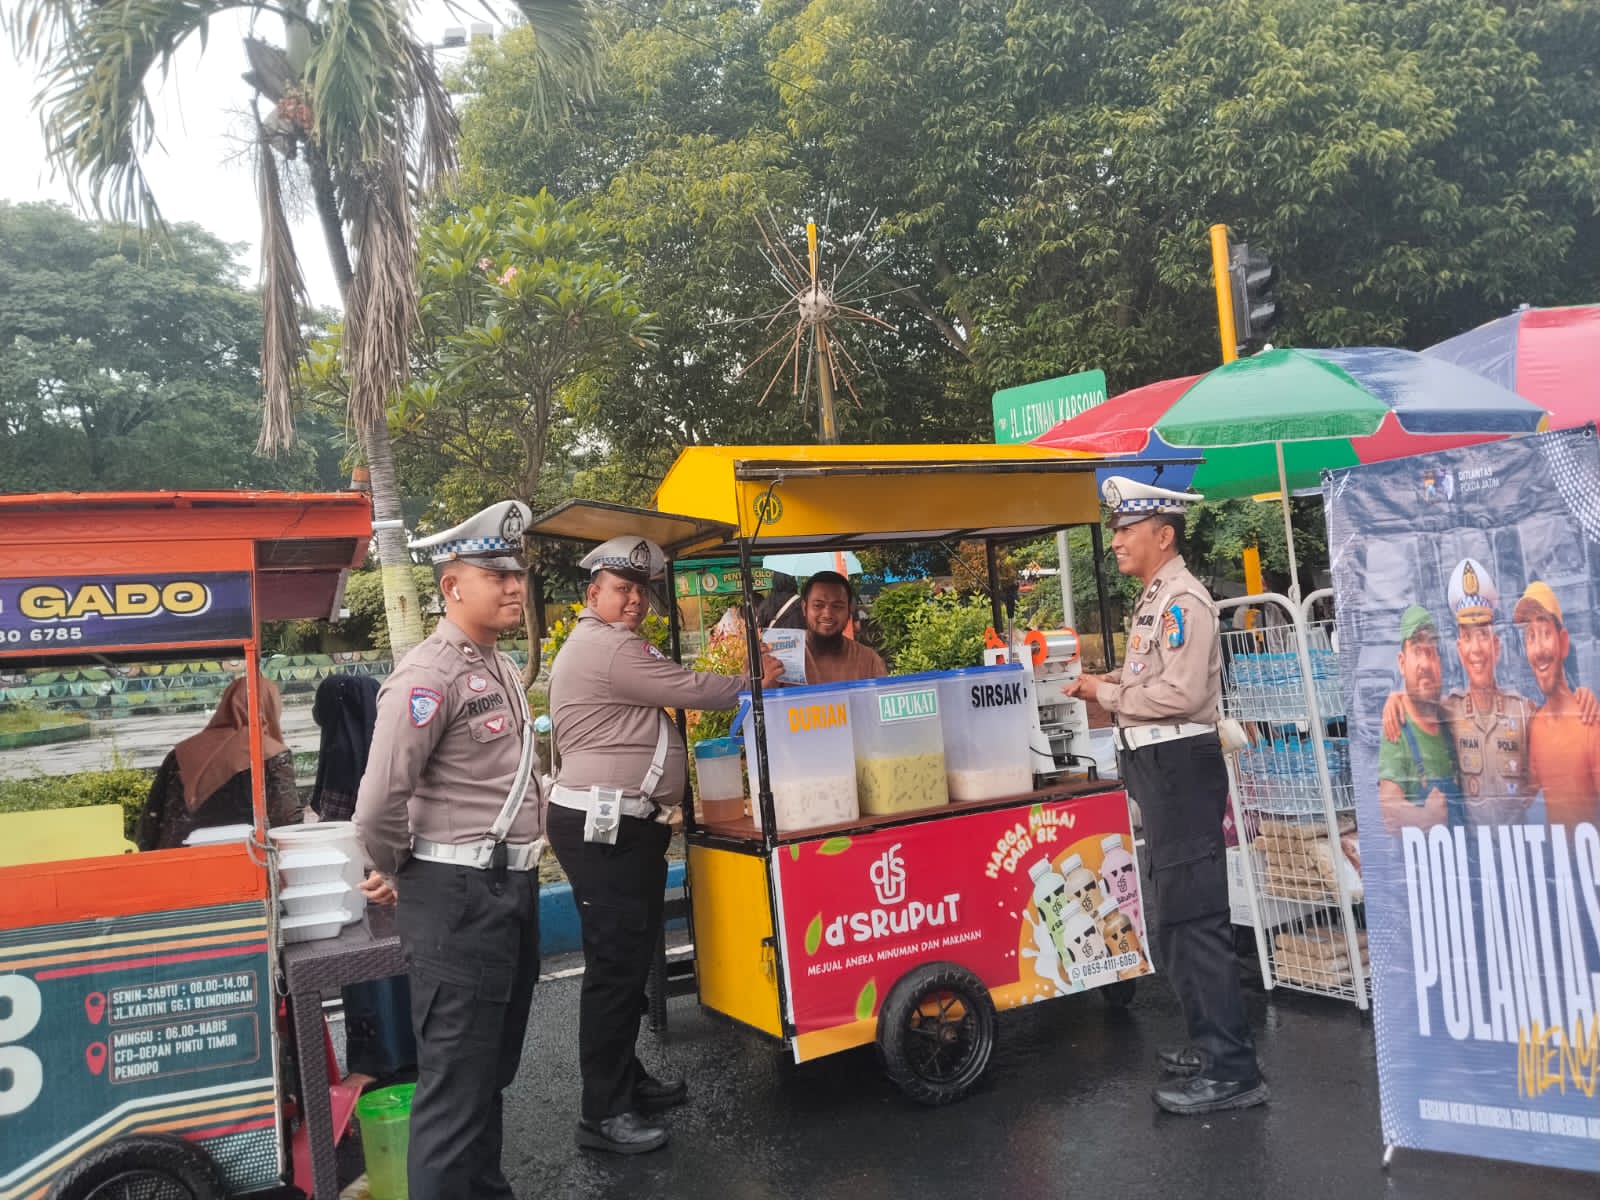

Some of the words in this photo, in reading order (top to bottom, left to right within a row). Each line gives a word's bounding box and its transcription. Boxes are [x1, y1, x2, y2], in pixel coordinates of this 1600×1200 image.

[1010, 408, 1021, 438] JL.
[19, 581, 211, 622] GADO
[30, 627, 82, 642] 6785
[467, 692, 504, 716] RIDHO
[882, 692, 935, 718] ALPUKAT
[971, 682, 1022, 708] SIRSAK
[787, 703, 848, 733] DURIAN
[985, 823, 1027, 879] HARGA
[1029, 809, 1076, 829] MULAI
[1003, 835, 1033, 873] DARI
[1036, 827, 1057, 844] 8K
[807, 961, 843, 976] MEJUAL
[846, 954, 874, 968] ANEKA
[877, 944, 919, 961] MINUMAN
[921, 938, 940, 951] DAN
[942, 930, 982, 945] MAKANAN
[113, 984, 178, 1004] SENIN-SABTU
[113, 1002, 167, 1020] JL.KARTINI
[194, 990, 253, 1009] BLINDUNGAN
[114, 1030, 153, 1048] MINGGU
[165, 1020, 228, 1040] 06.00-HABIS
[114, 1045, 172, 1063] CFD-DEPAN
[175, 1039, 204, 1055] PINTU
[206, 1033, 238, 1049] TIMUR
[1518, 1008, 1600, 1098] MENY
[115, 1061, 159, 1080] PENDOPO
